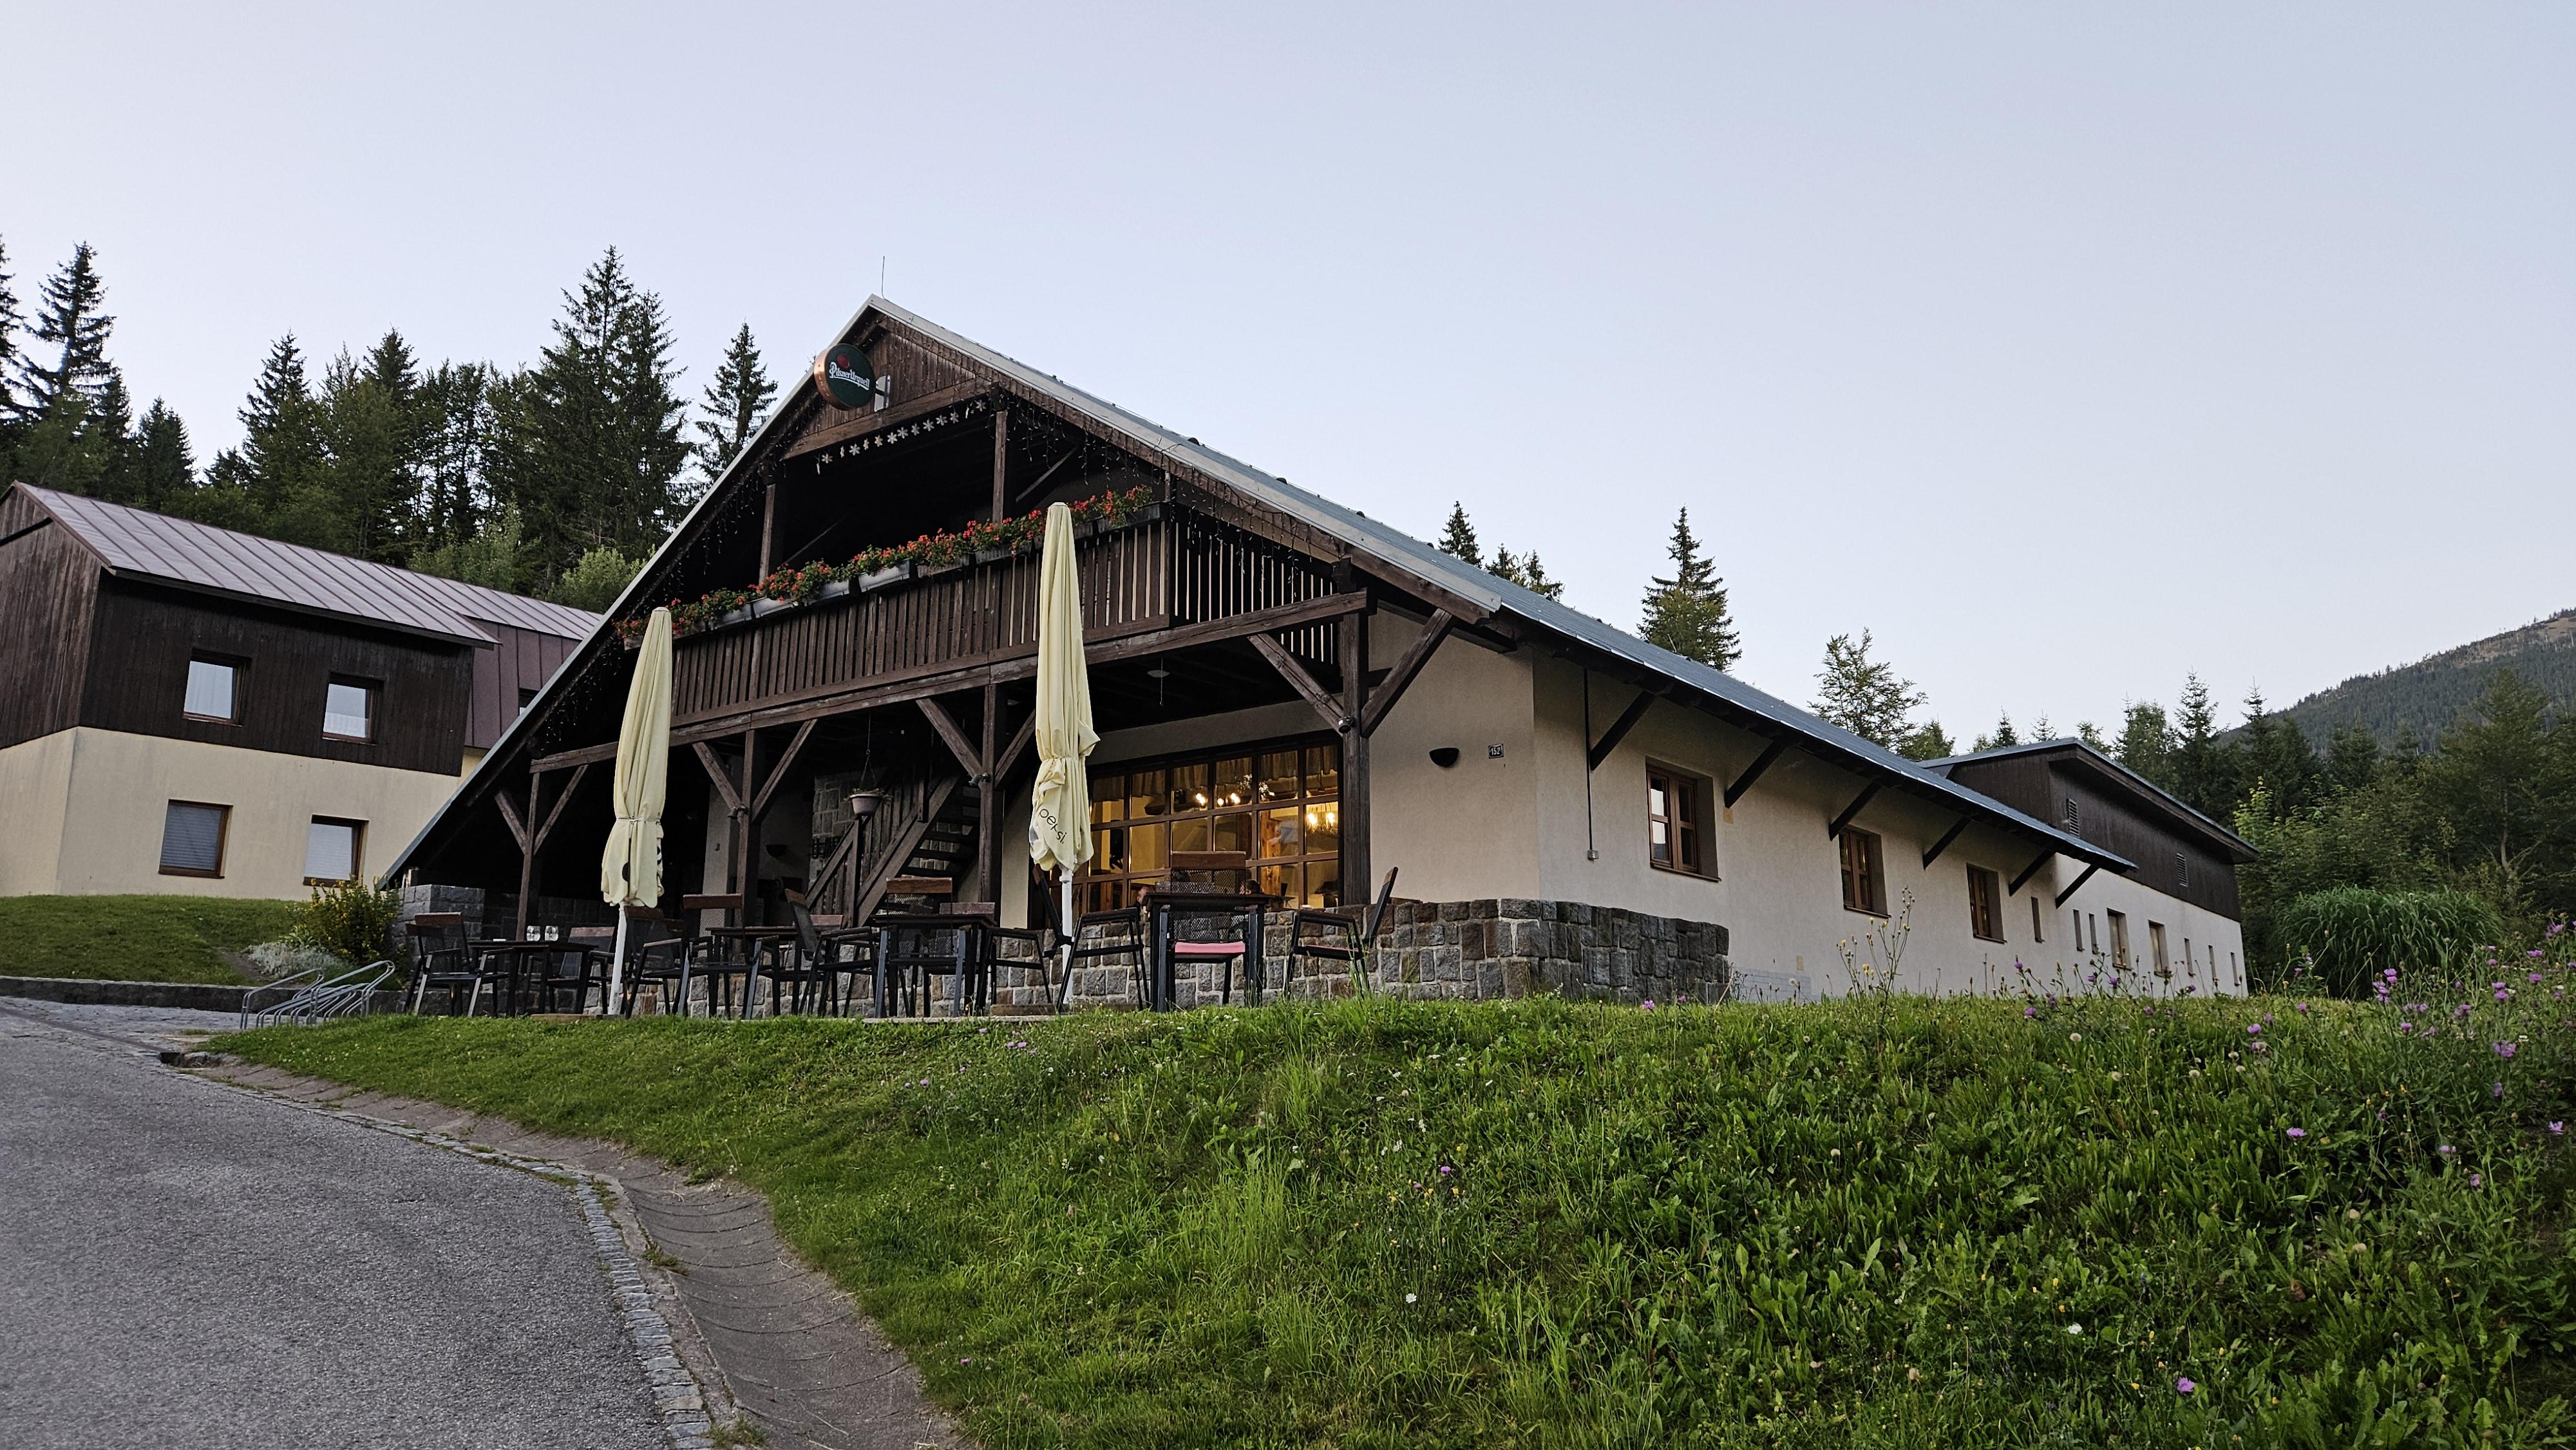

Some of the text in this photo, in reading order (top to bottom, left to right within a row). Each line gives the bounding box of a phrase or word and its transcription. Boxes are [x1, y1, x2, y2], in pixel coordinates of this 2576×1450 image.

[829, 361, 870, 388] Pilsner Urquell
[1491, 747, 1501, 756] 152
